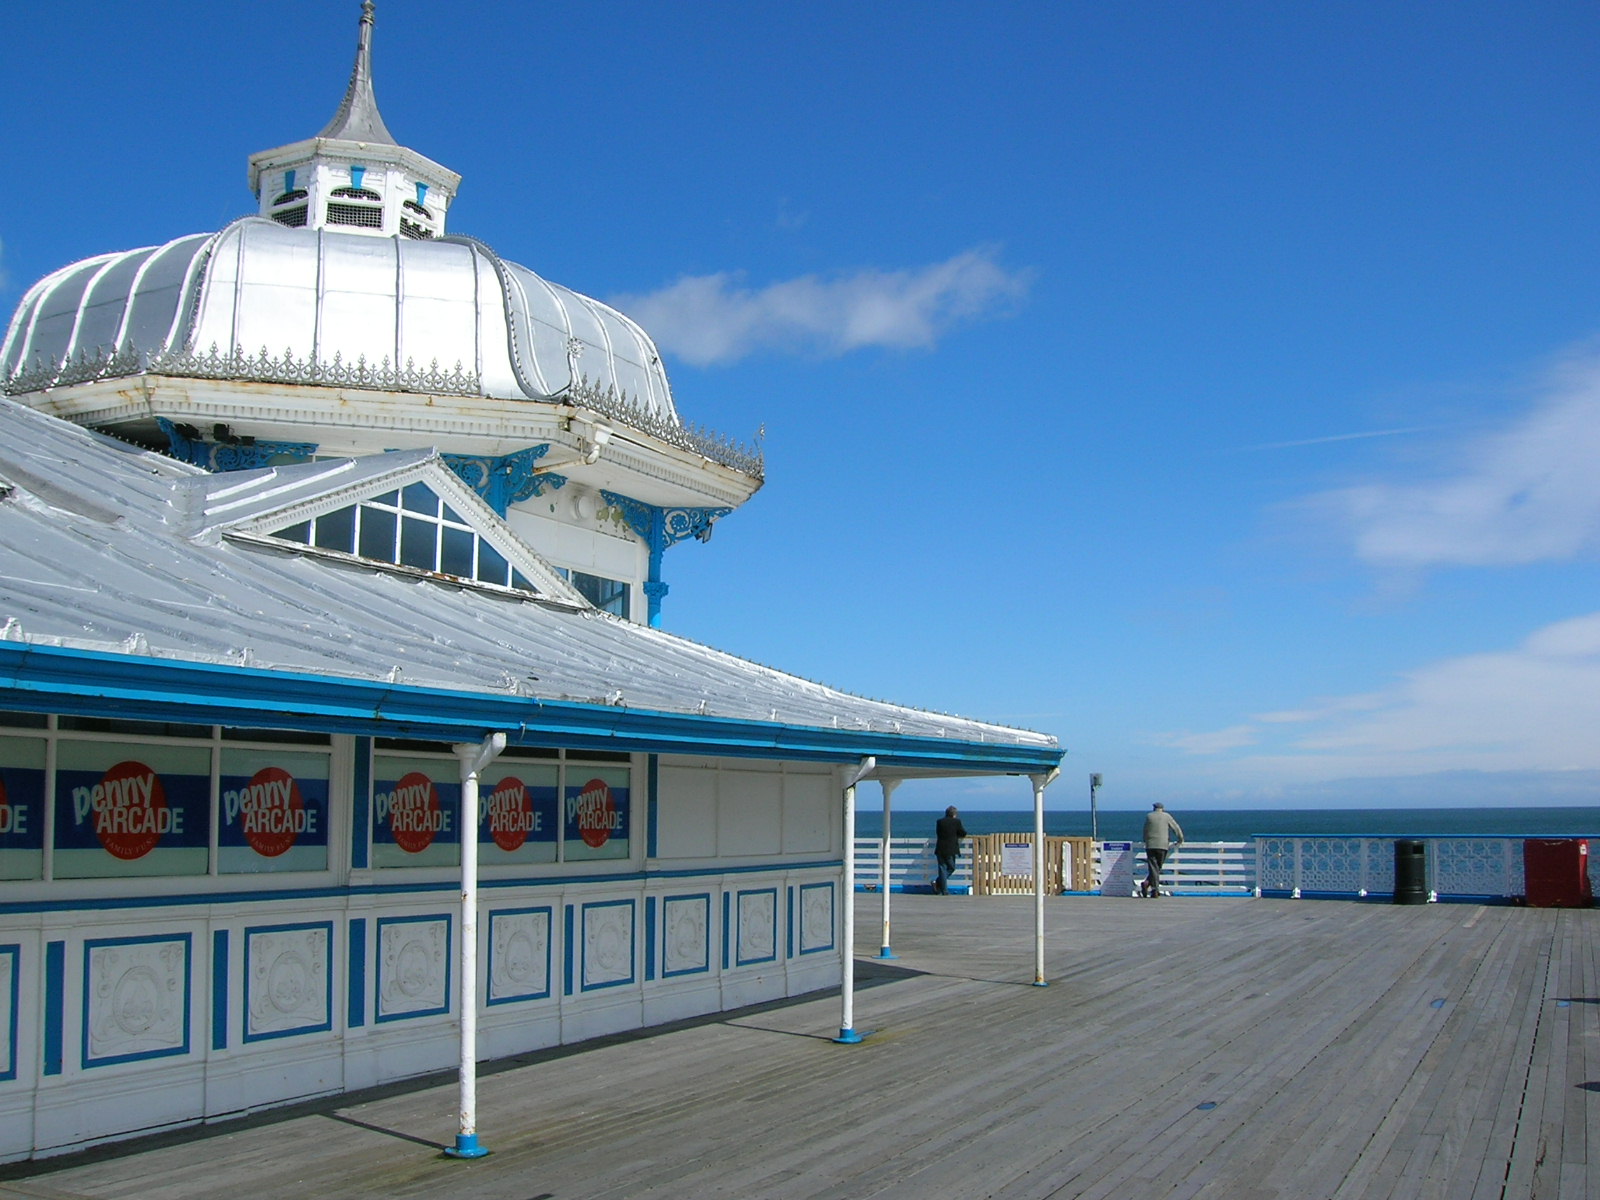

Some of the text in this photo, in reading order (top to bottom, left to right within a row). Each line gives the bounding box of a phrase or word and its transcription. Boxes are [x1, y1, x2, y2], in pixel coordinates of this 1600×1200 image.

[71, 773, 155, 826] penny
[223, 777, 293, 826] penny
[375, 782, 431, 824] penny
[478, 785, 524, 826] penny
[567, 787, 608, 824] penny
[96, 806, 184, 834] ARCADE
[243, 808, 317, 833] ARCADE
[391, 809, 452, 832] ARCADE
[490, 811, 542, 832] ARCADE
[579, 811, 623, 830] ARCADE
